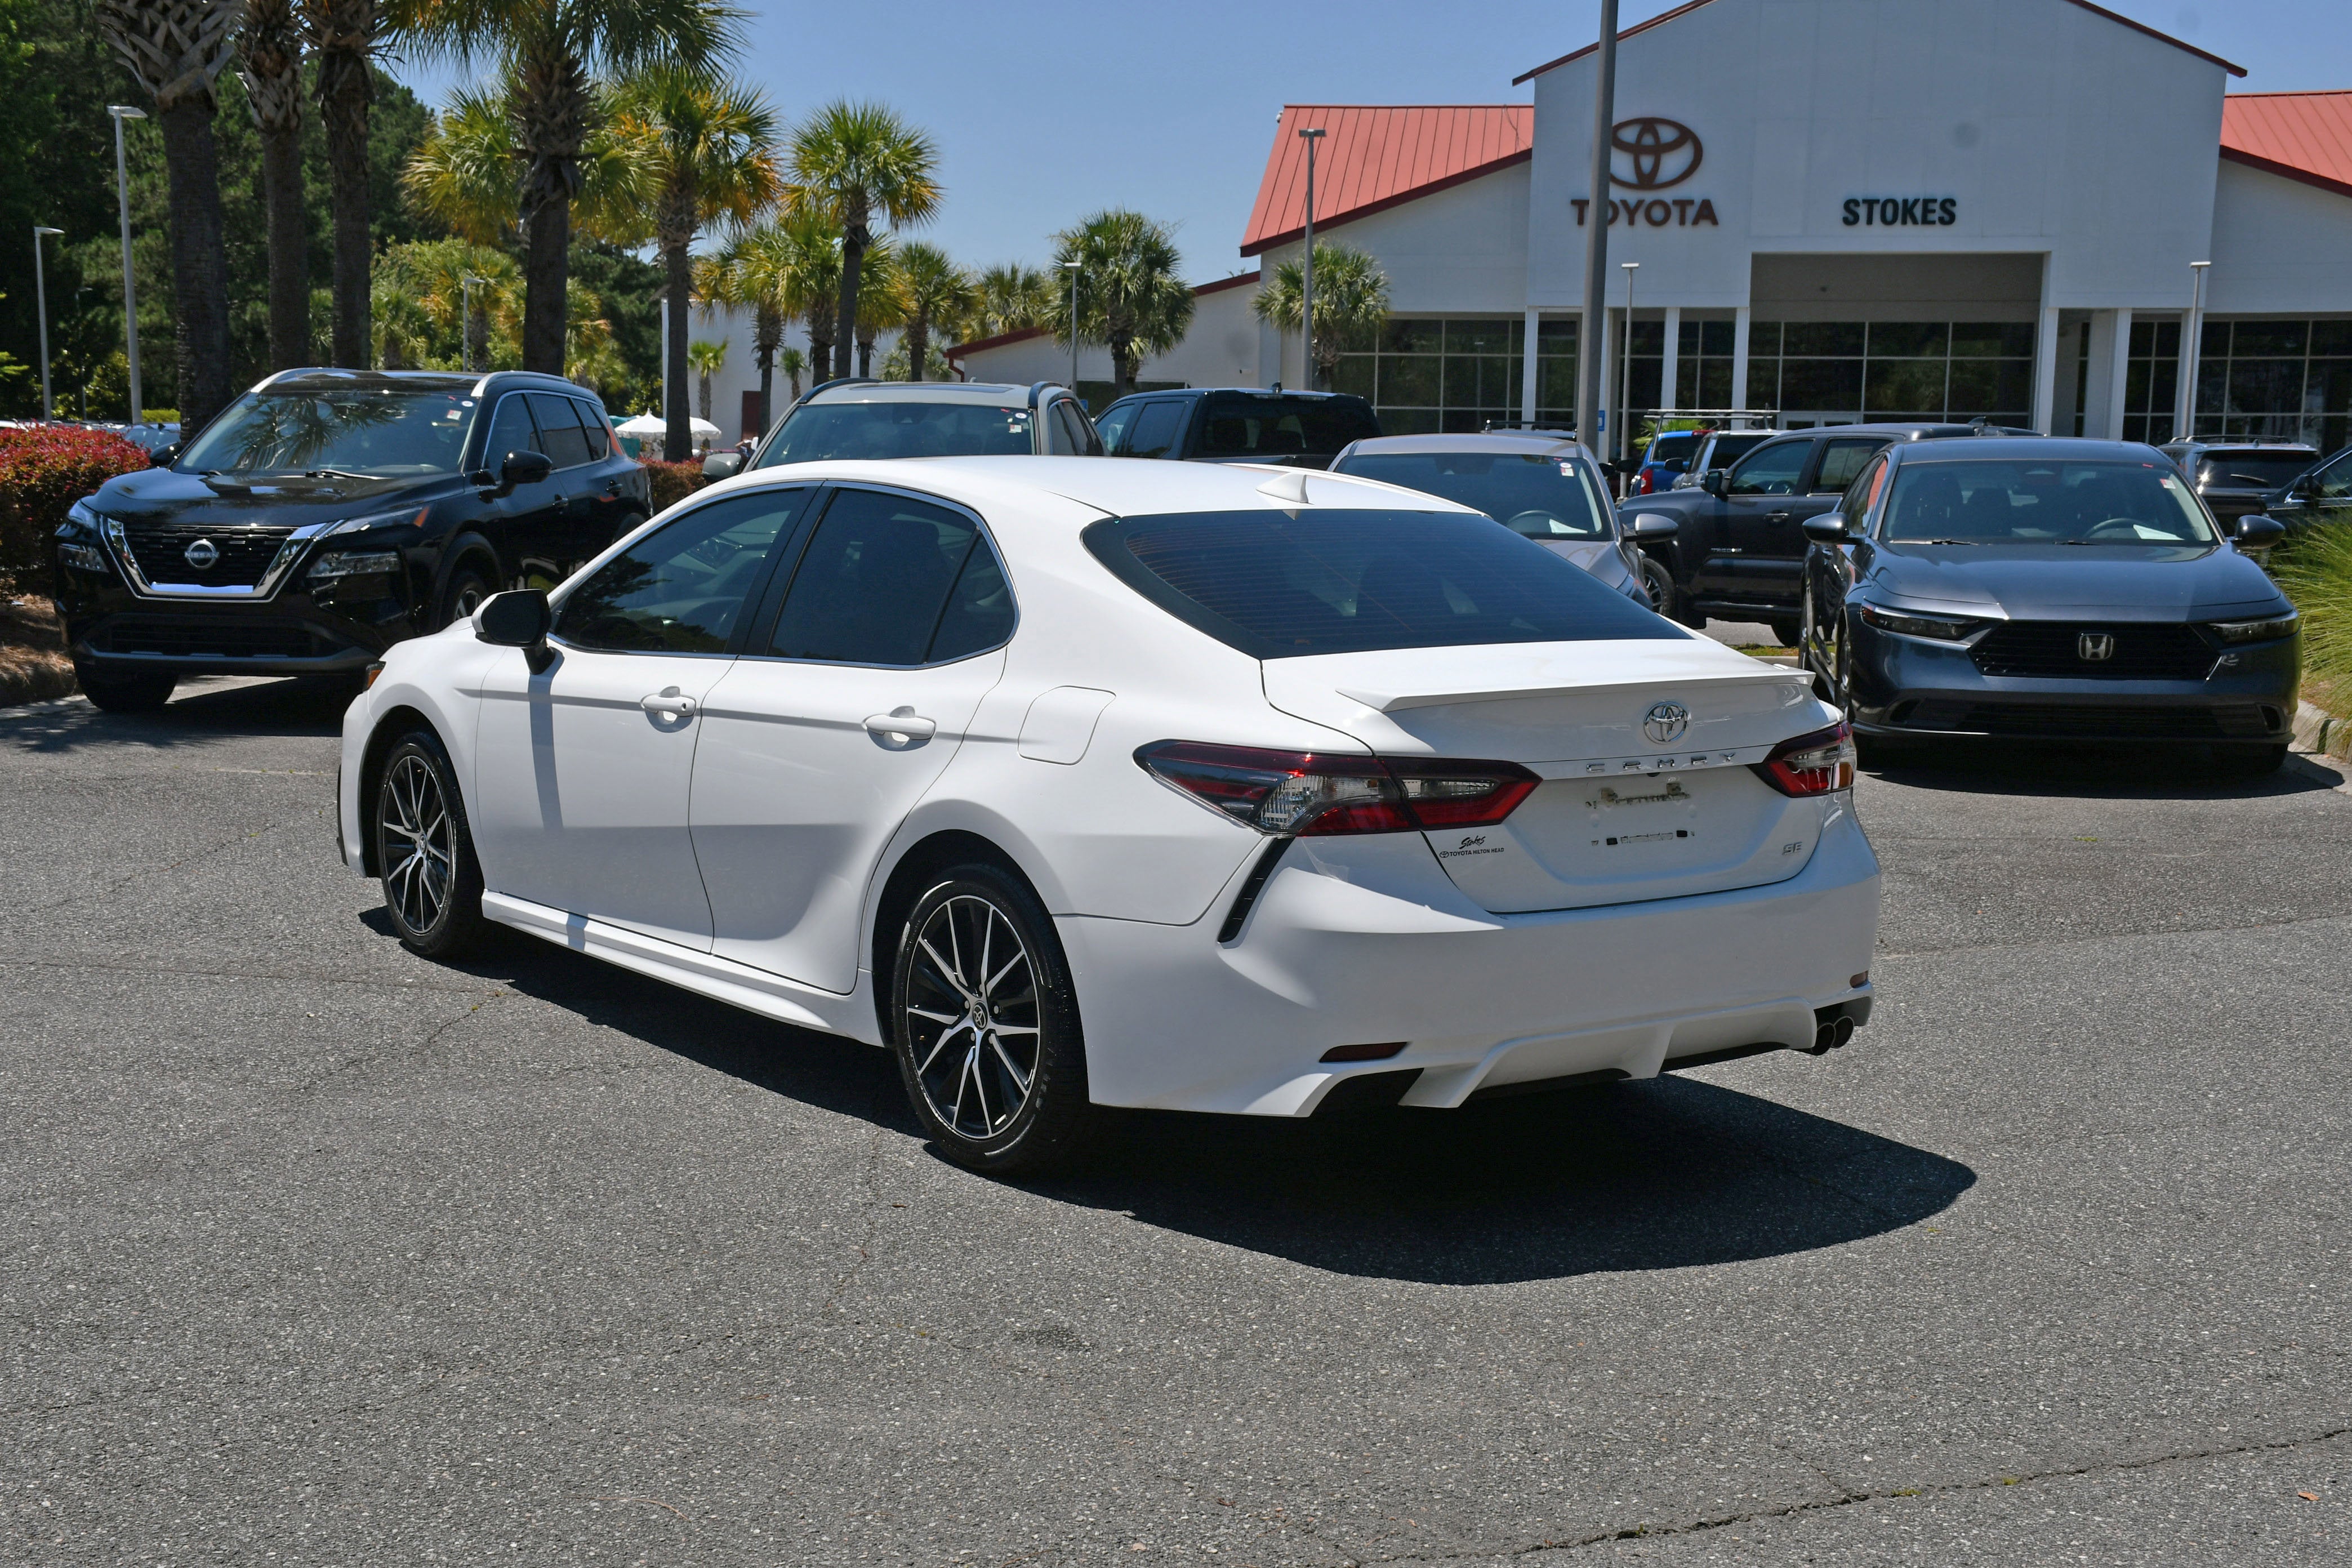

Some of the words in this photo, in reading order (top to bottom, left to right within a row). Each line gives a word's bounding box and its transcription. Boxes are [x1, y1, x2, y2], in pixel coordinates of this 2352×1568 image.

[1842, 198, 1957, 225] STOKES
[1586, 752, 1736, 772] CAMRY
[1459, 835, 1486, 849] Stokes
[1782, 841, 1802, 855] SE
